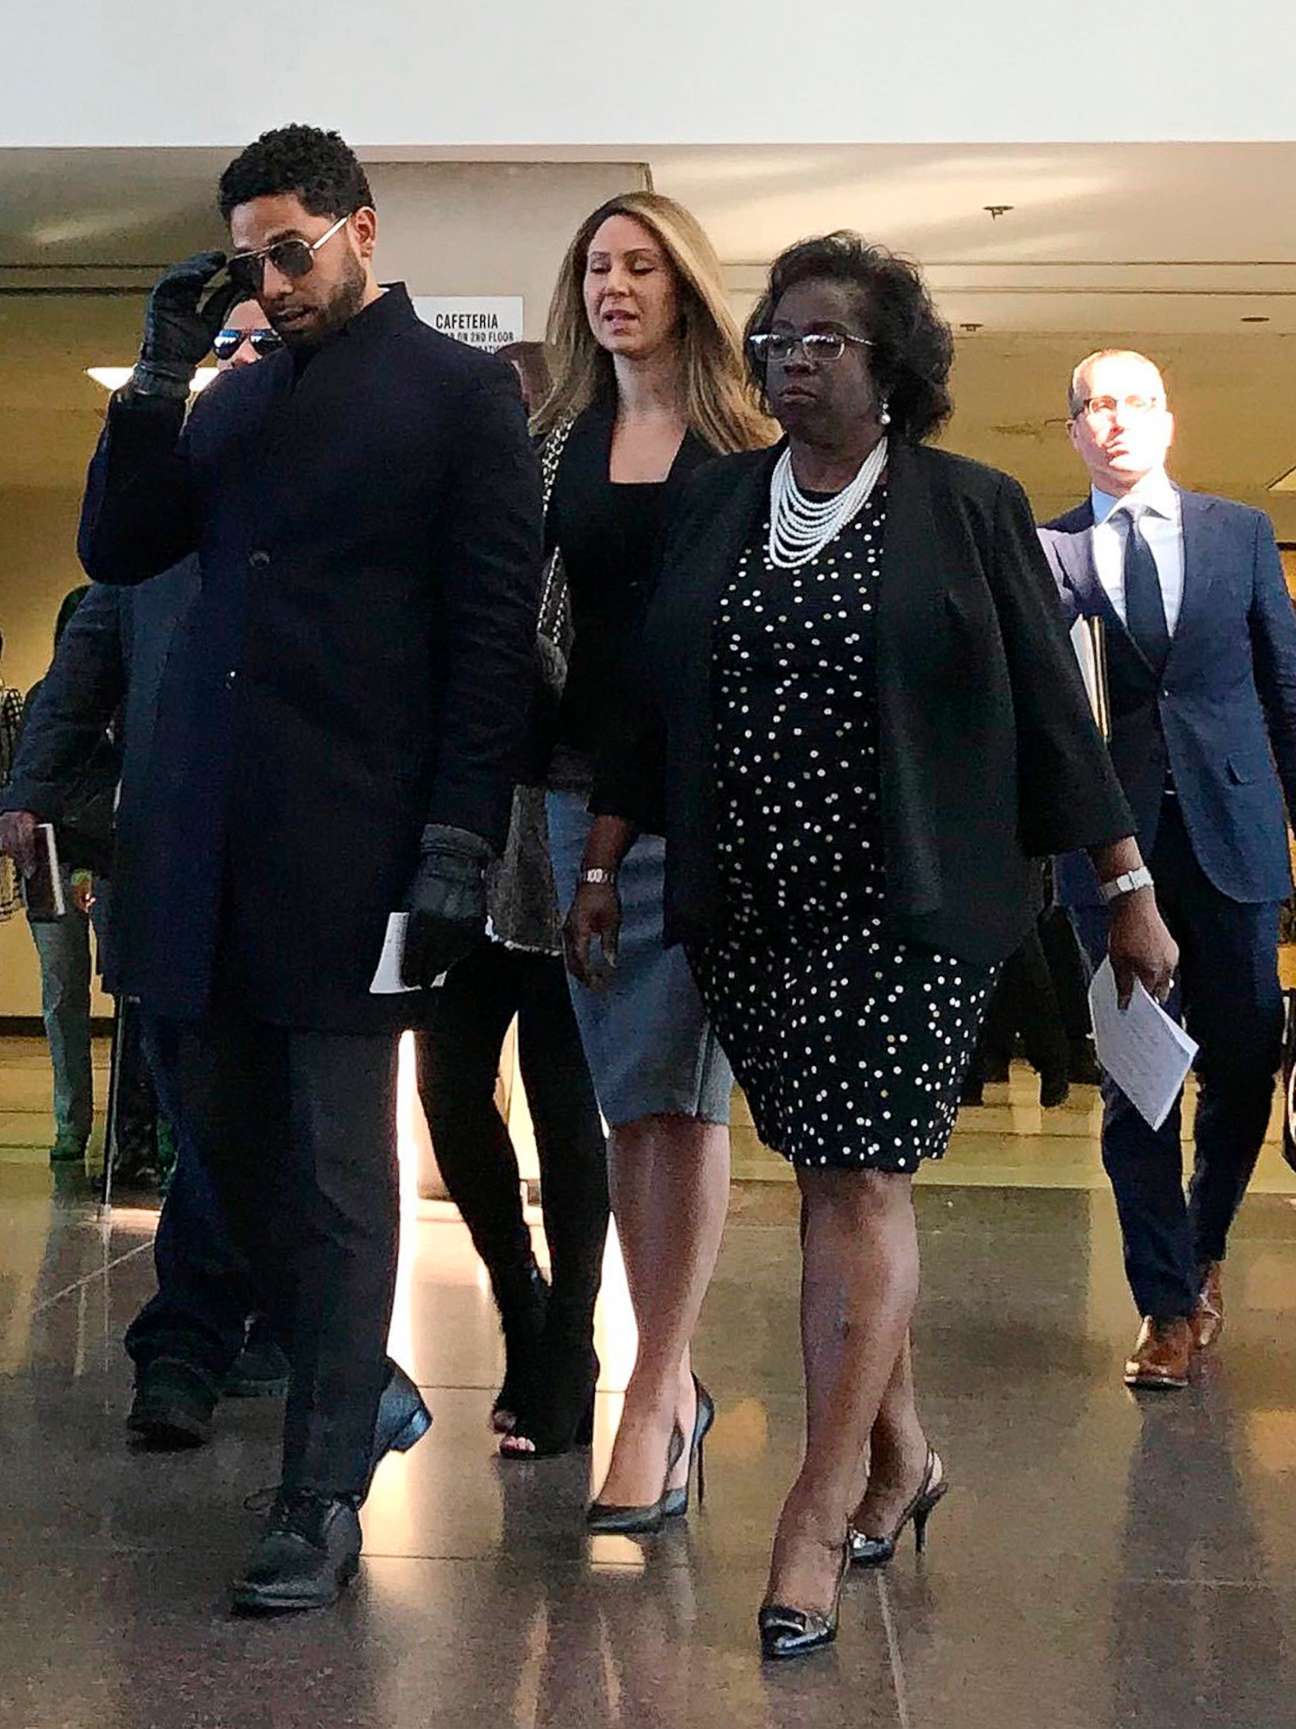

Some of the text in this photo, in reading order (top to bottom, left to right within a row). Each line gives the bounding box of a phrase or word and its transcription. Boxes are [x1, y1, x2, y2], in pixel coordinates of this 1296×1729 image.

[436, 314, 498, 329] CAFETERIA
[471, 332, 486, 342] 2ND
[488, 332, 514, 342] FLOOR
